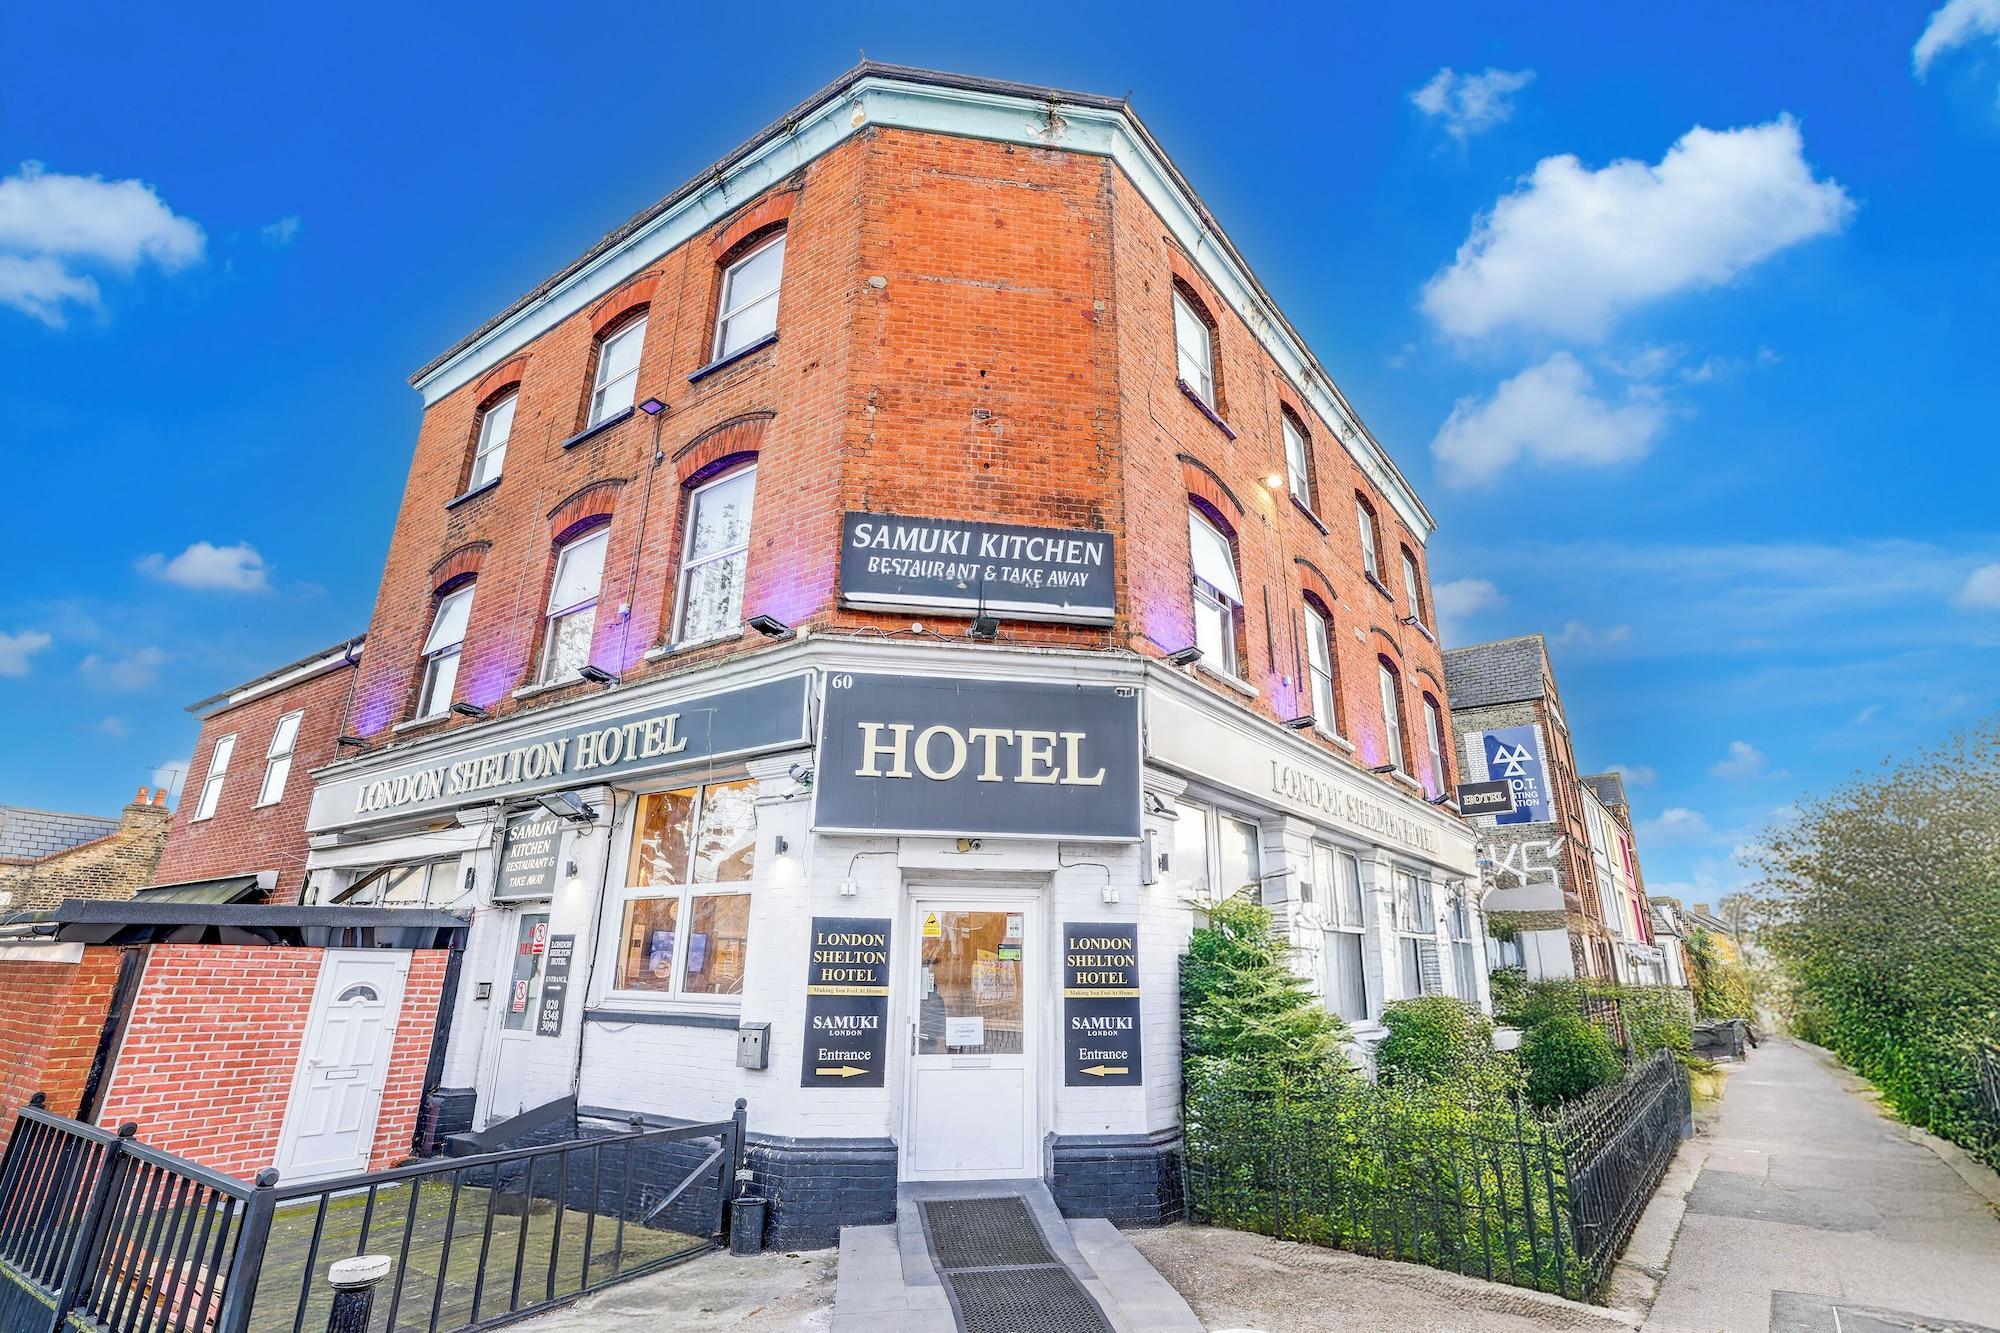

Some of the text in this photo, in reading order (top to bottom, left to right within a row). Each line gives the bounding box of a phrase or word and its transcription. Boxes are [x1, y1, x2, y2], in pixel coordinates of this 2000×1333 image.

[852, 523, 1104, 566] SAMUKI KITCHEN
[868, 556, 1089, 587] RESTAURANT & TAKE AWAY
[832, 674, 853, 690] 60
[855, 721, 1106, 787] HOTEL
[353, 713, 688, 813] LONDON SHELTON HOTEL
[1512, 777, 1538, 791] O.T.
[1462, 792, 1507, 806] HOTEL
[1513, 791, 1539, 800] STING
[1271, 759, 1440, 854] LONDON SHELTON HOTEL
[509, 819, 559, 841] SAMUKI
[511, 840, 551, 858] KITCHEN
[505, 856, 555, 872] RESTAURANT &
[509, 874, 545, 887] TAKE AWAY
[551, 940, 573, 949] LONDON
[817, 932, 886, 947] LONDON
[1069, 938, 1132, 950] LONDON
[813, 950, 887, 965] SHELTON
[1067, 954, 1135, 968] SHELTON
[821, 968, 877, 982] HOTEL
[1076, 971, 1128, 985] HOTEL
[813, 1015, 879, 1030] SAMUKI
[1071, 1017, 1133, 1030] SAMUKI
[818, 1048, 872, 1061] Entrance
[1078, 1048, 1128, 1060] Entrance
